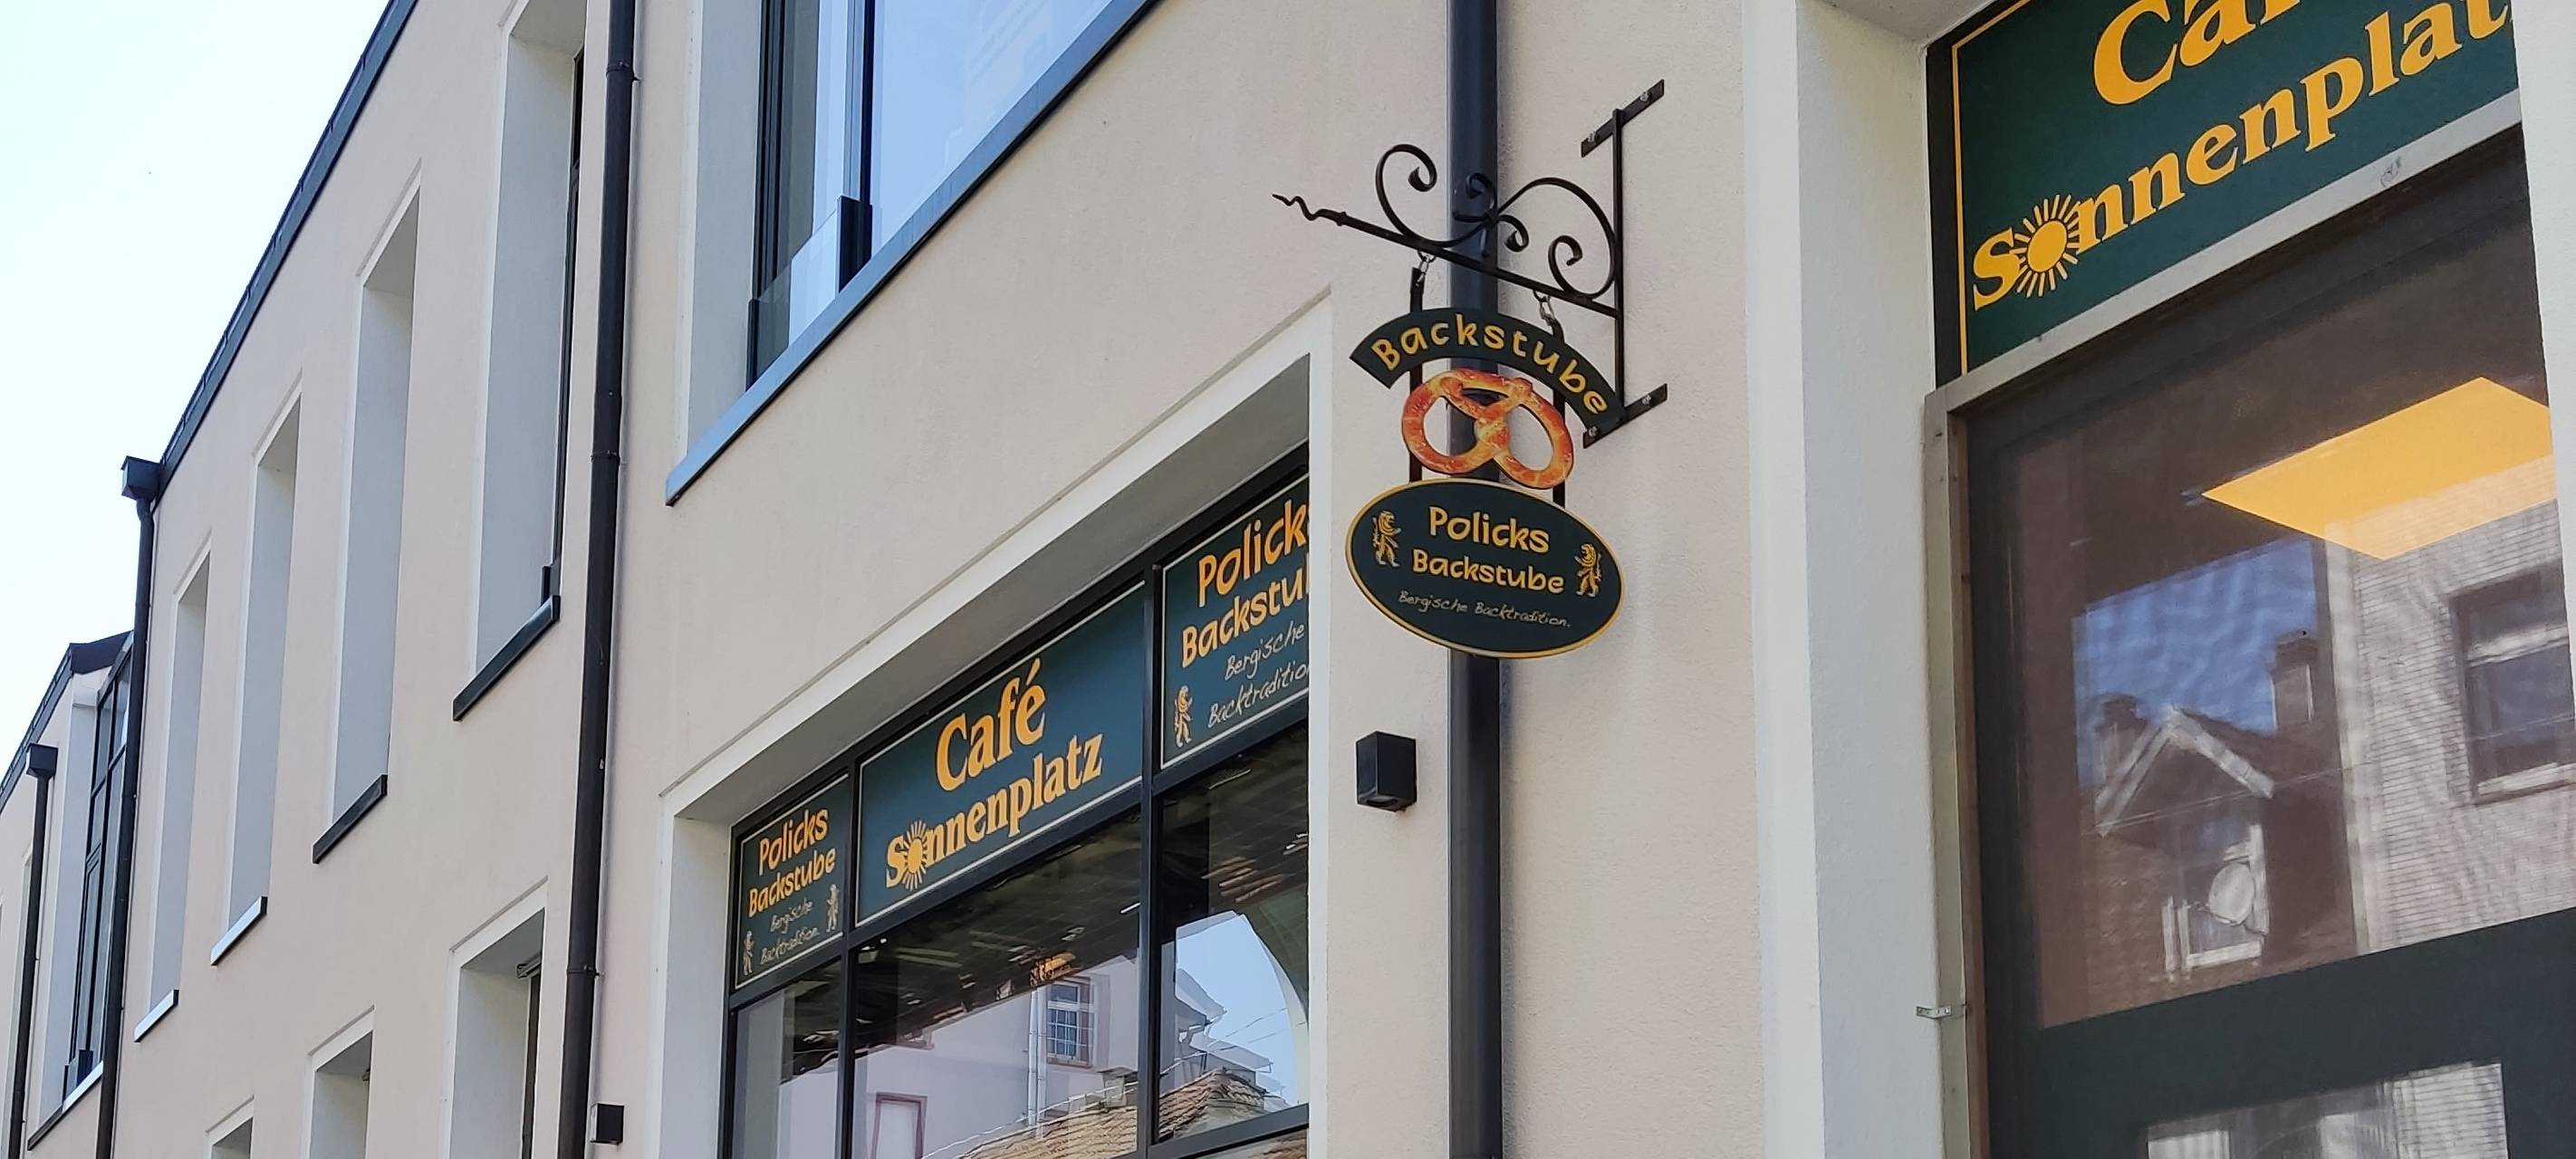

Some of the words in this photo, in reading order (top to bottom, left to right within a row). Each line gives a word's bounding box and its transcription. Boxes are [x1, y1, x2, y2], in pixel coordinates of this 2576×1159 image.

[1973, 0, 2510, 311] Sonnenplat
[1370, 313, 1608, 416] Backstube
[1197, 499, 1309, 608] Polick
[1428, 506, 1550, 554] Policks
[1412, 549, 1564, 594] Backstube
[1398, 590, 1468, 612] Bergische
[1475, 601, 1572, 628] Backtradition.
[1225, 620, 1305, 681] Bergische
[936, 657, 1046, 792] Café
[1207, 661, 1309, 729] Backtraditio
[759, 809, 829, 876] Policks
[886, 732, 1103, 890] Sonnenplatz
[748, 847, 836, 918] Backstube
[771, 896, 813, 934] Bergische
